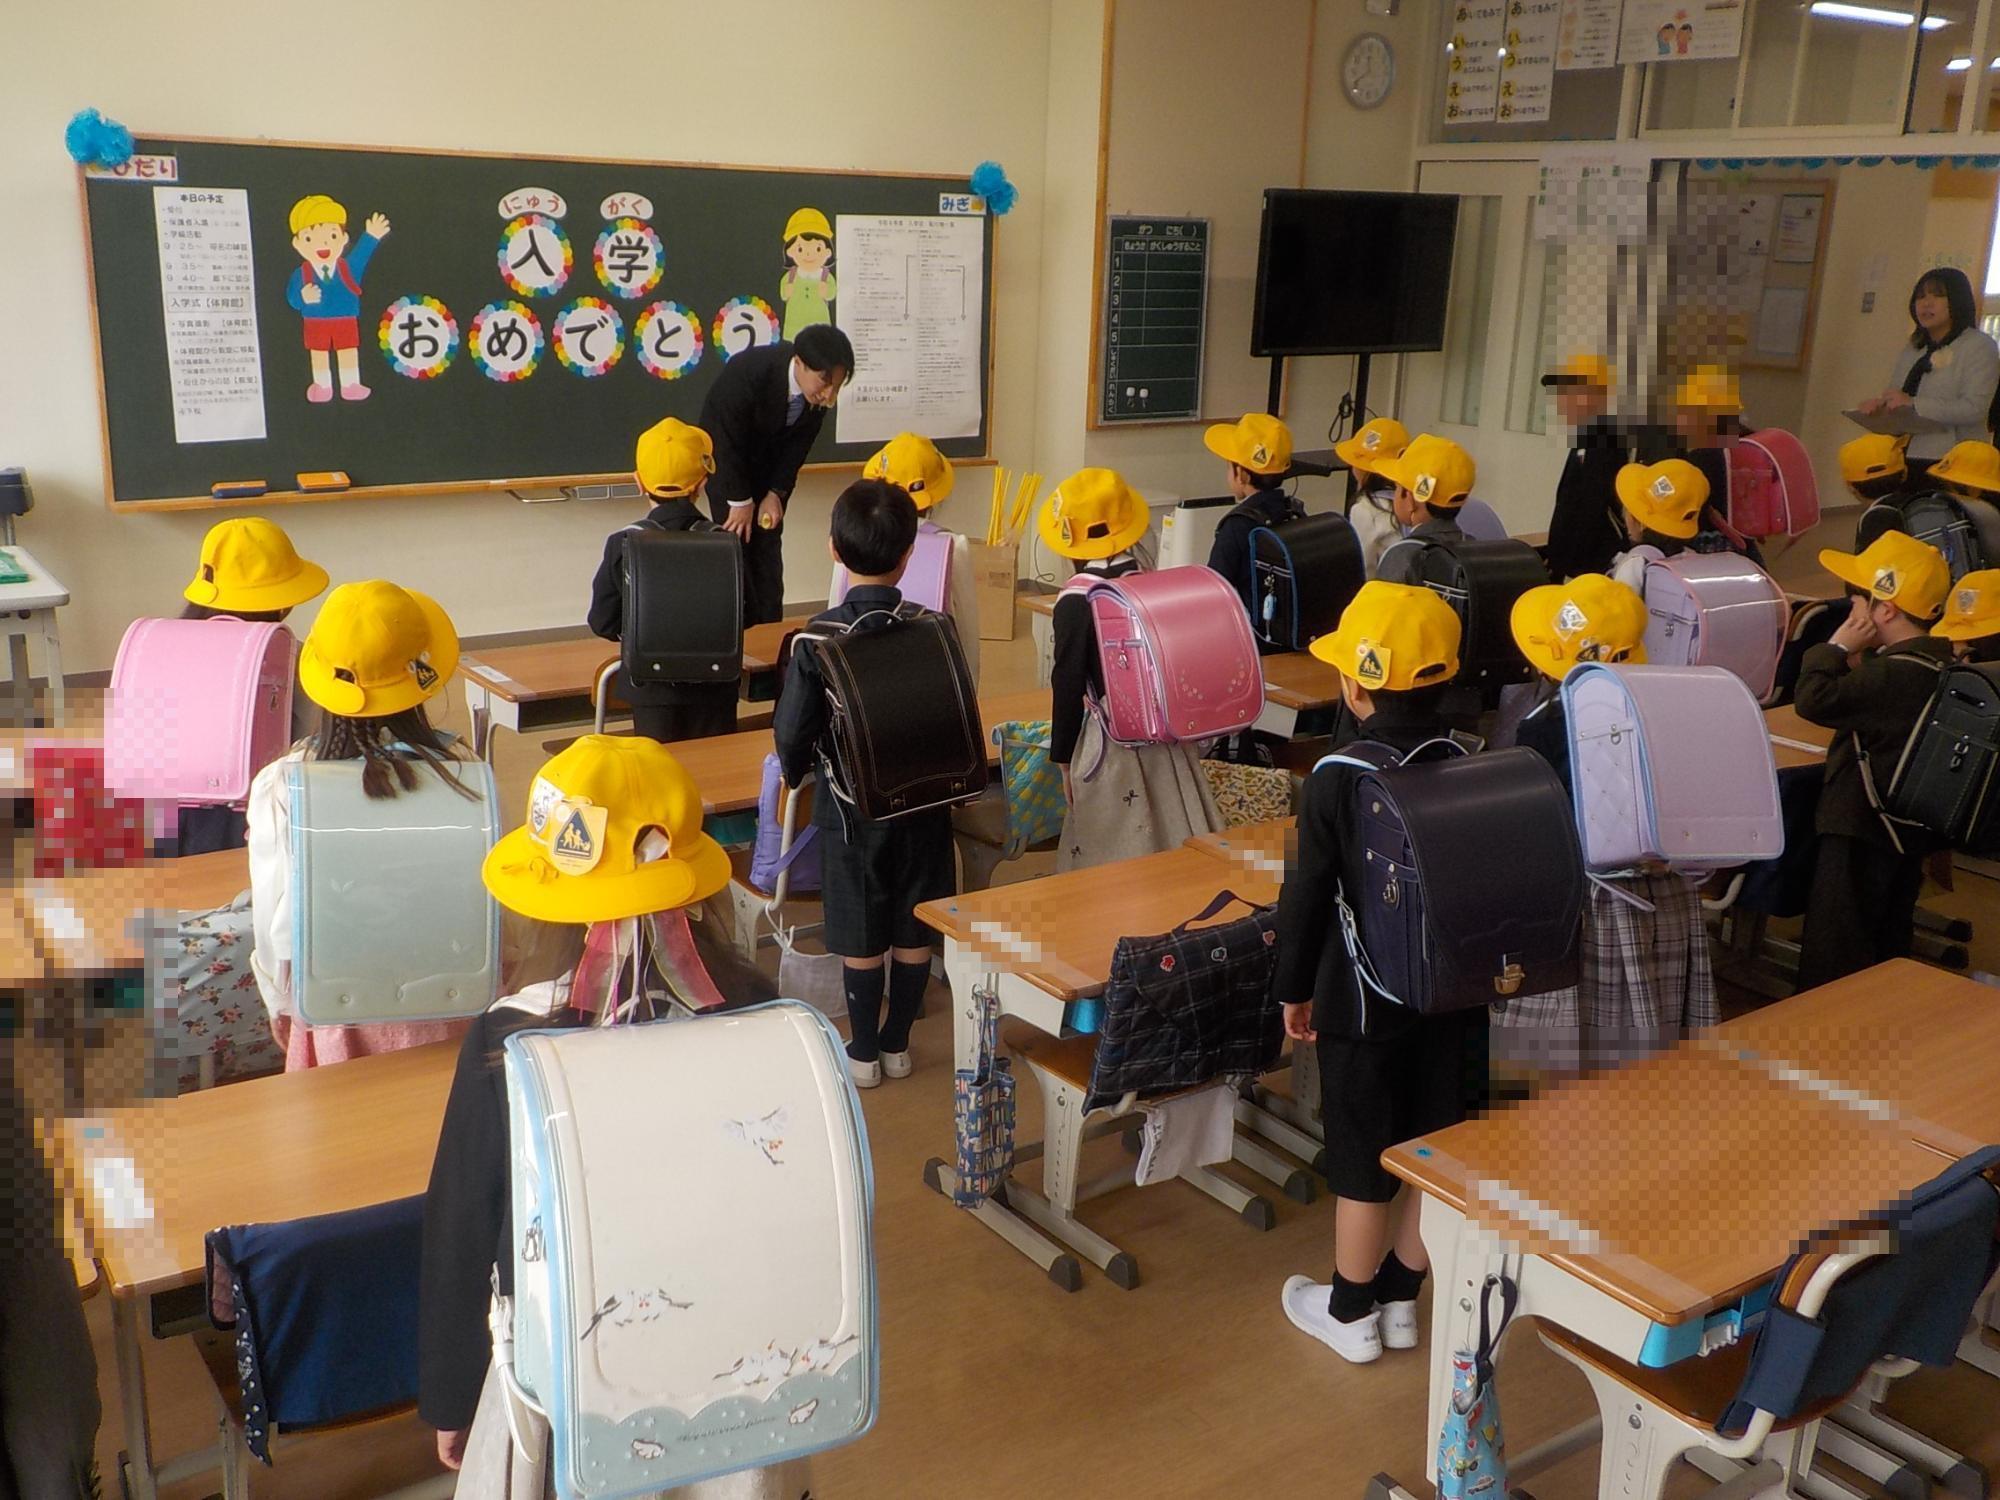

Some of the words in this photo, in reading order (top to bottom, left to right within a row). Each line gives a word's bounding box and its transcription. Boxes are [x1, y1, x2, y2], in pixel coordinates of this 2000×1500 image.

[112, 158, 175, 177] ひだり
[179, 193, 224, 204] 本日の予定
[503, 194, 560, 212] にゅう
[942, 197, 969, 212] みぎ
[607, 198, 643, 215] がく
[1137, 224, 1153, 235] がつ
[1124, 241, 1146, 251] きょうか
[1150, 241, 1201, 251] がくしゅうすること
[511, 229, 649, 283] 入学
[1114, 256, 1120, 268] 1
[1113, 275, 1120, 287] 2
[1112, 294, 1120, 305] 3
[1112, 313, 1119, 323] 4
[398, 312, 756, 362] おめでとう
[1111, 332, 1118, 342] 5
